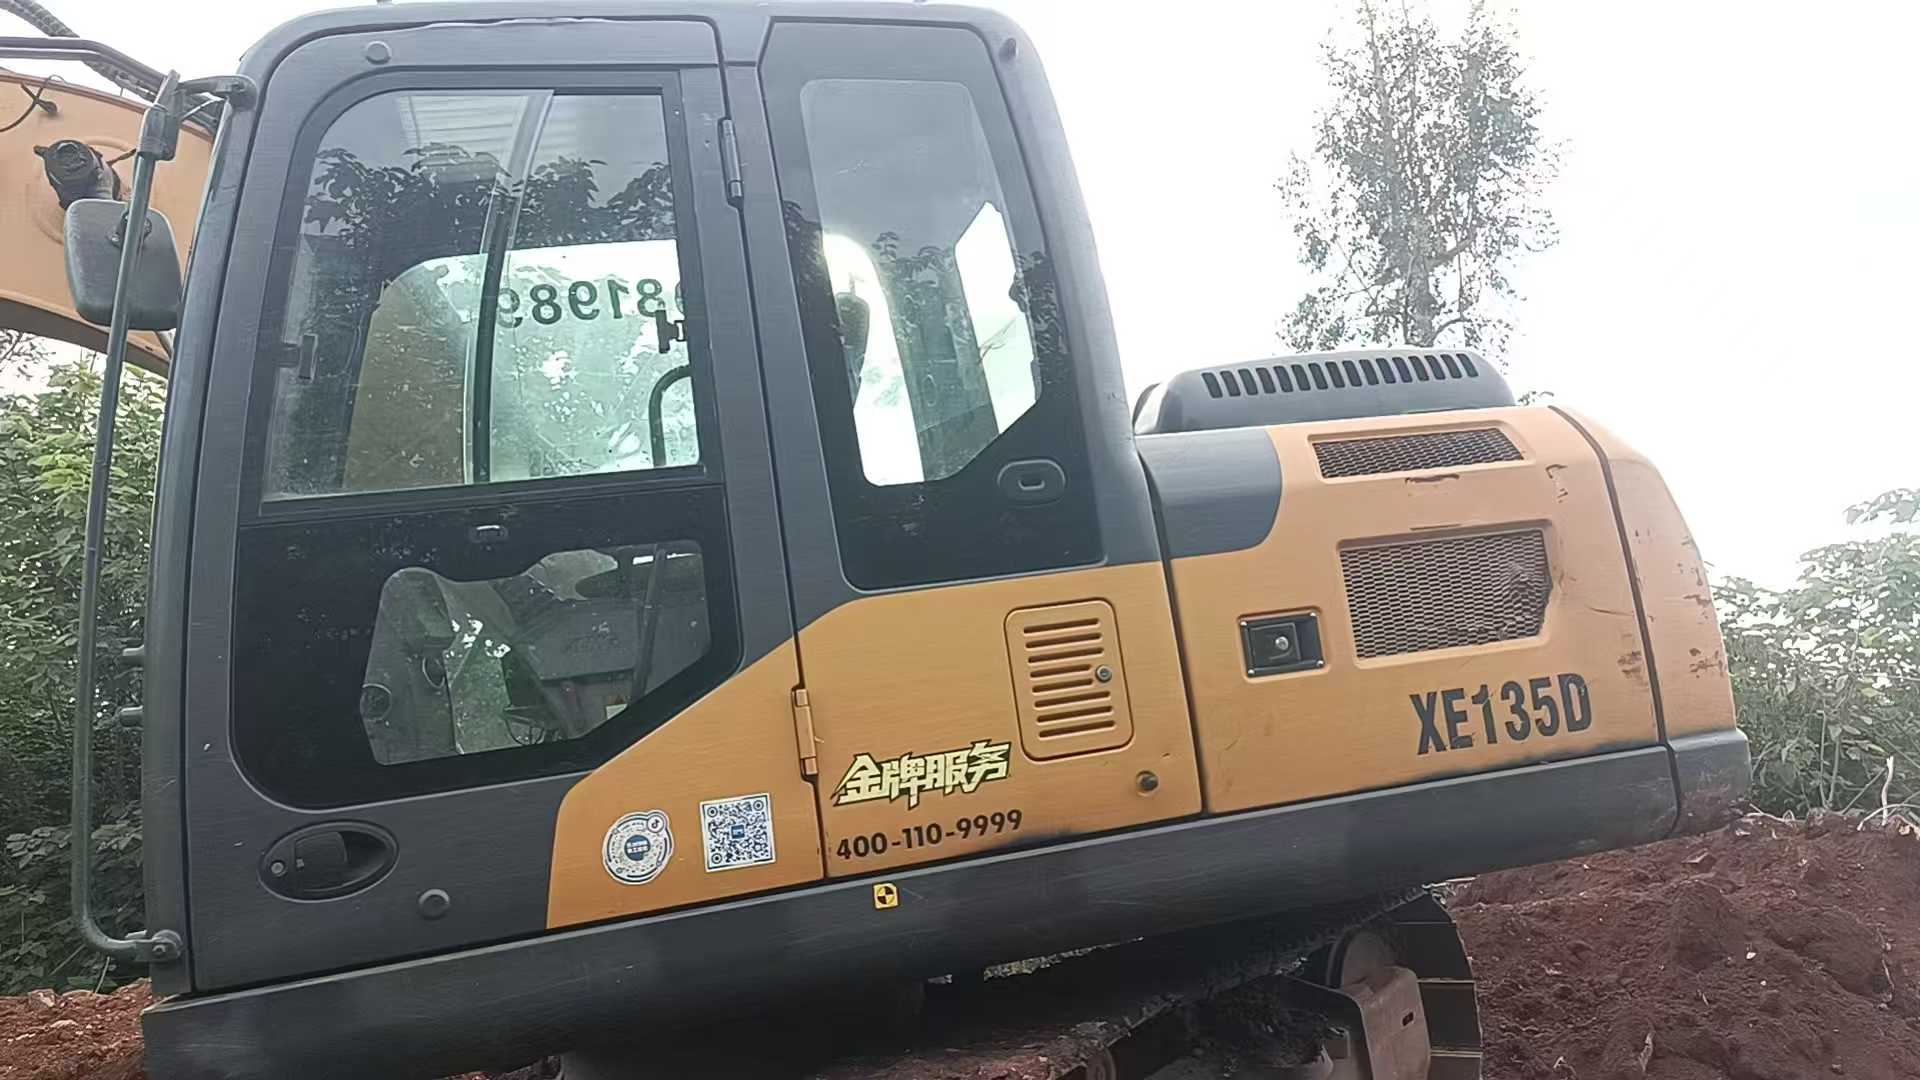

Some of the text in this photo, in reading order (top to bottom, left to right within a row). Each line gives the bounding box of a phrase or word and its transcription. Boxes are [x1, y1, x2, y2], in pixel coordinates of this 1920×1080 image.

[1409, 673, 1592, 755] XE135D
[830, 739, 1012, 811] 金牌服务
[836, 809, 1022, 860] 400-110-9999
